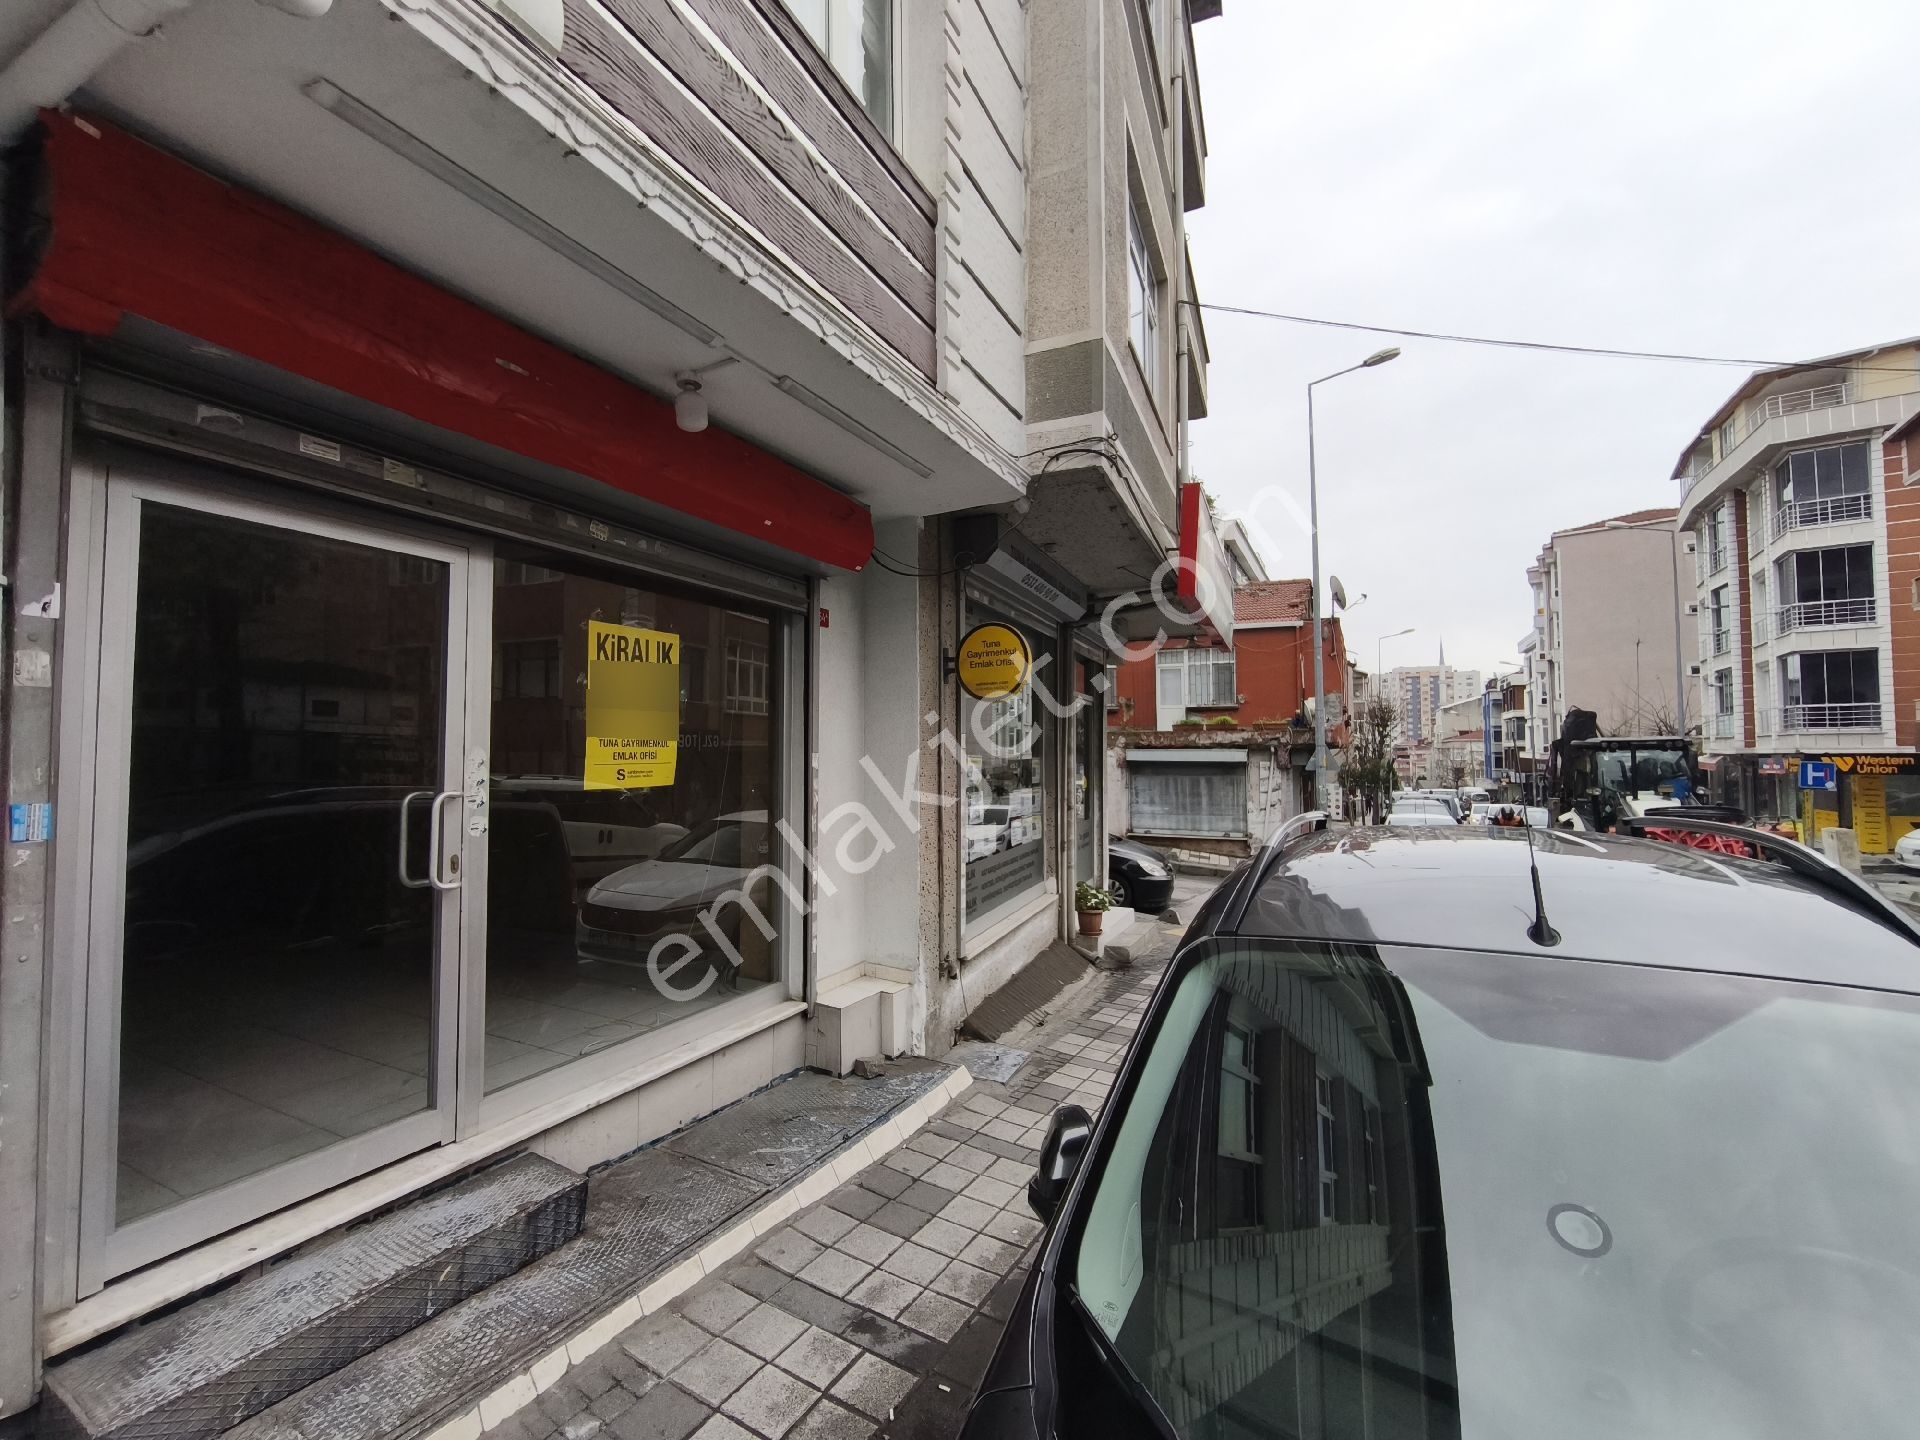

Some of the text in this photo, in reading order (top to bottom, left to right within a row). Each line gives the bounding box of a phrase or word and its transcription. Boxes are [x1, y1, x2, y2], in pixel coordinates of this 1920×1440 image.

[981, 640, 1001, 648] Tuna
[969, 660, 994, 669] Emlak
[599, 739, 619, 747] TUNA
[612, 751, 638, 760] EMLAK
[1856, 755, 1915, 765] Western
[1857, 765, 1898, 774] Union
